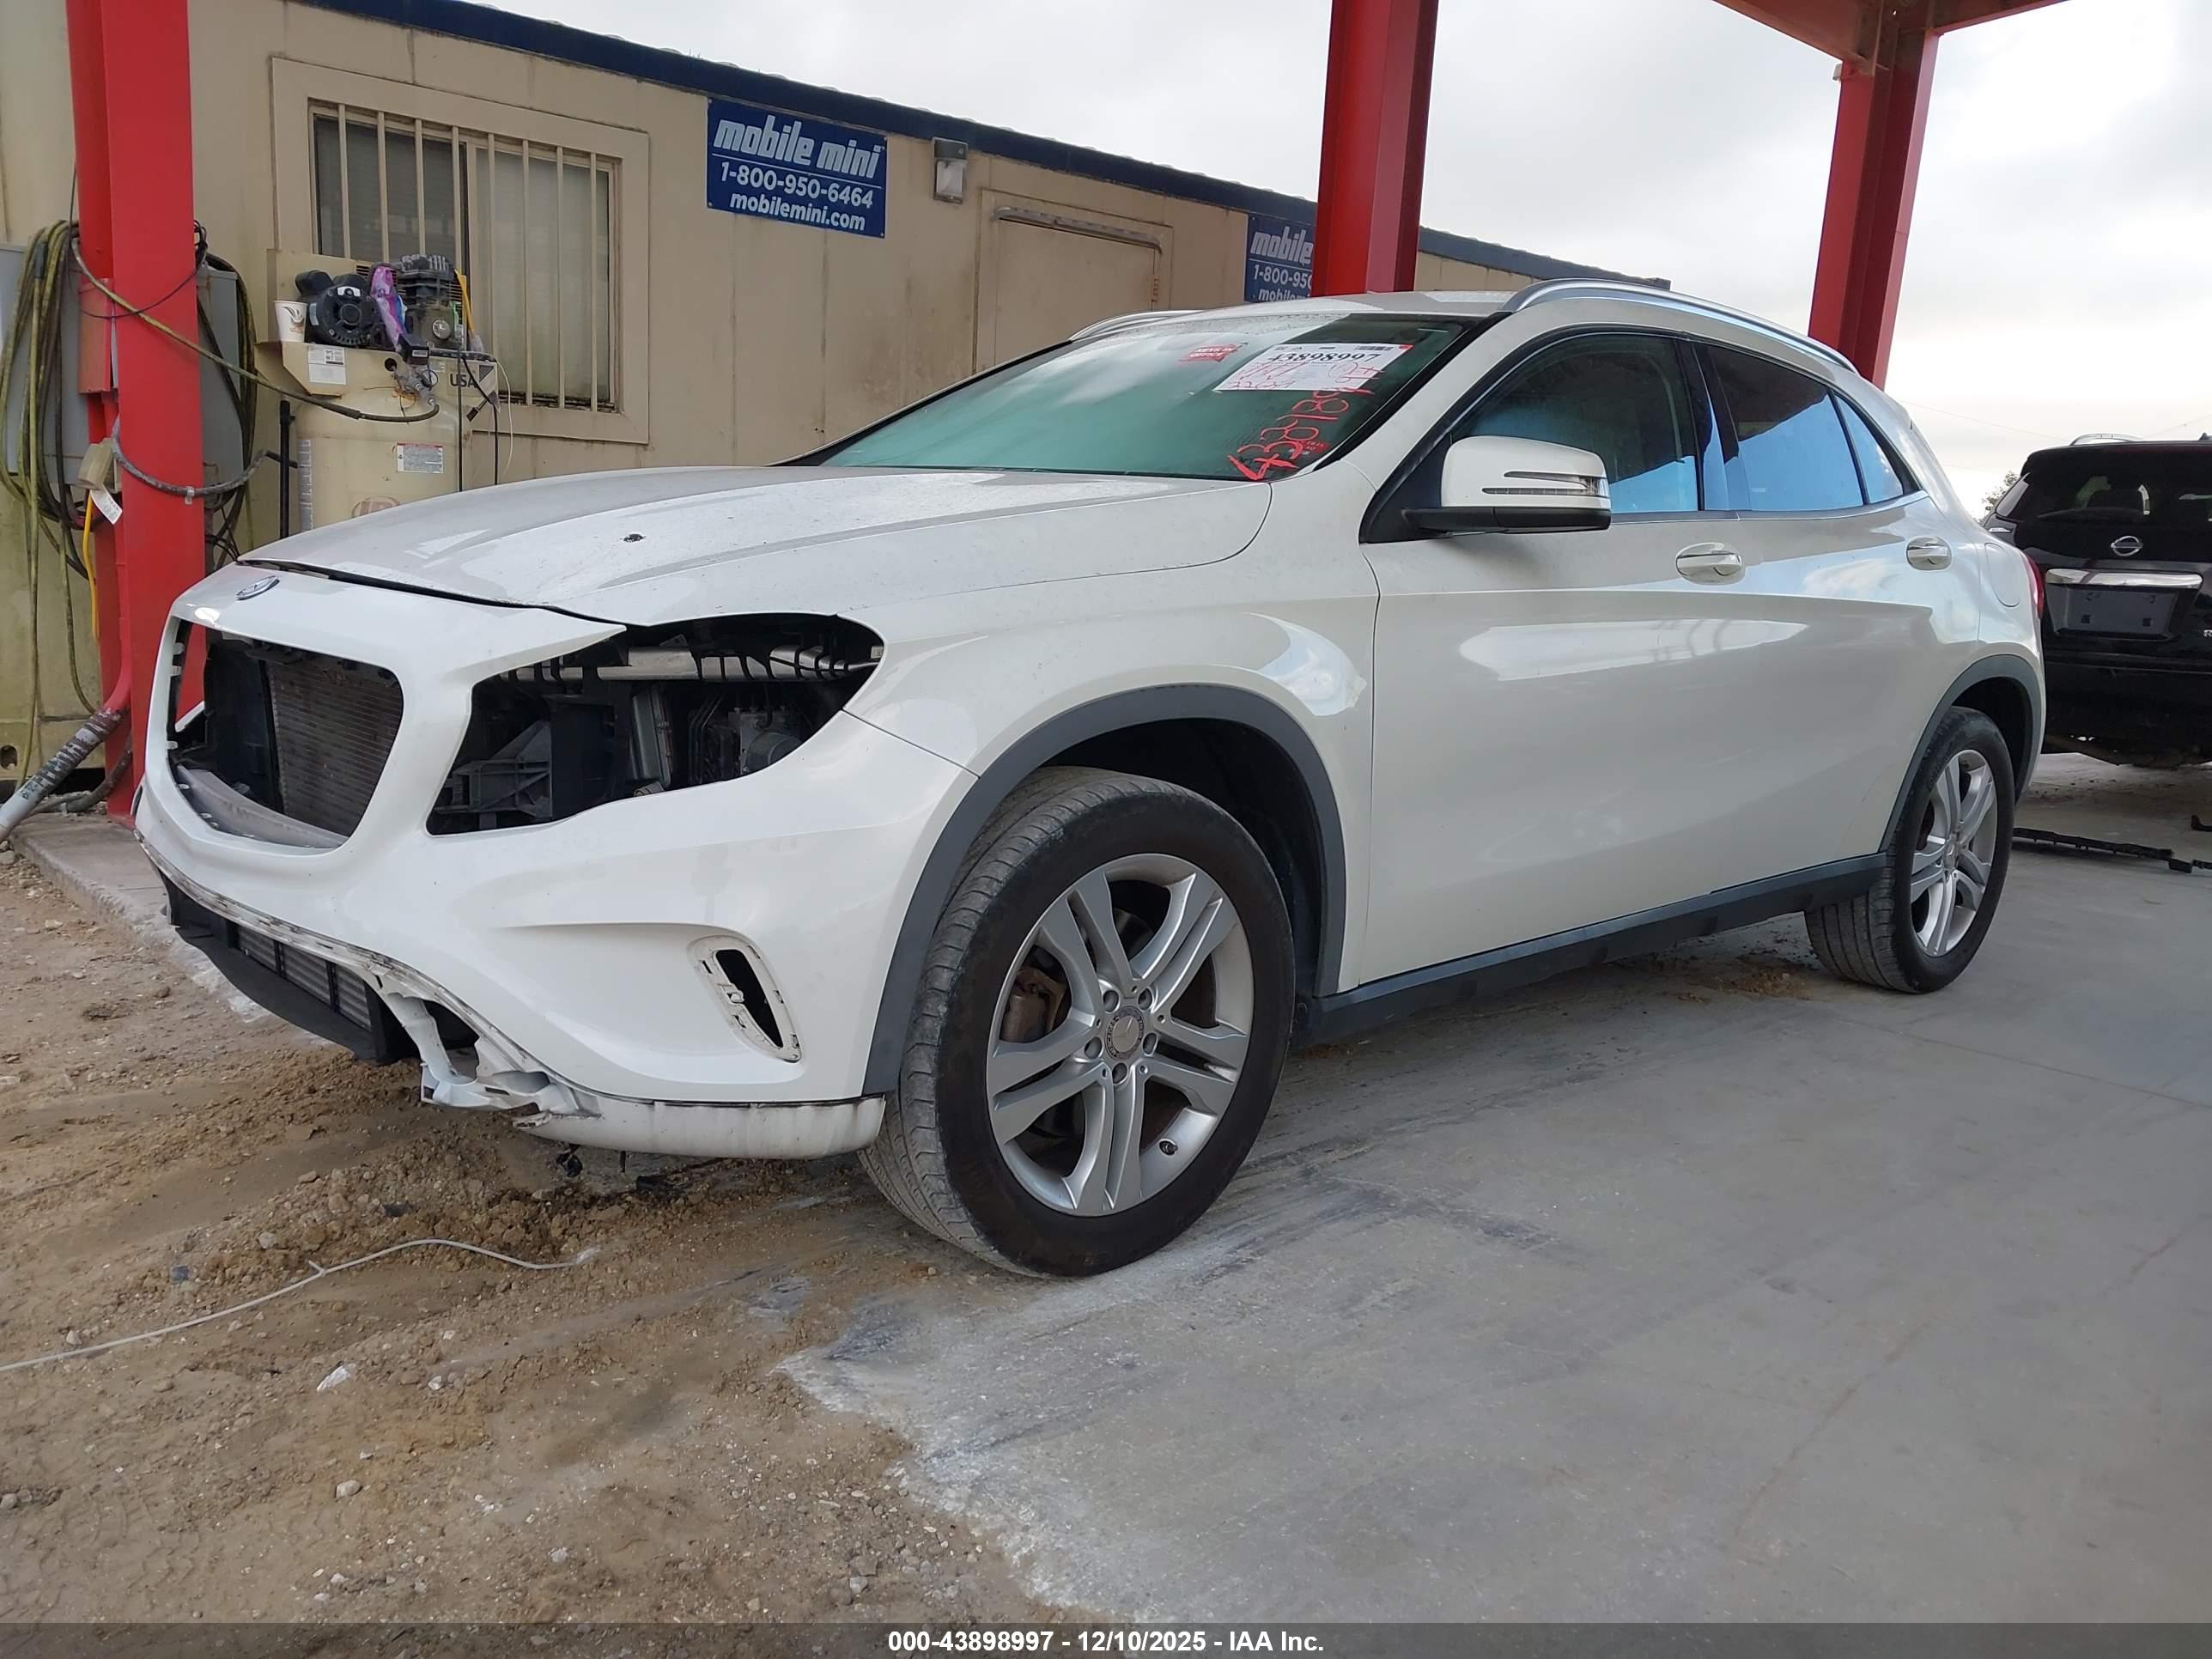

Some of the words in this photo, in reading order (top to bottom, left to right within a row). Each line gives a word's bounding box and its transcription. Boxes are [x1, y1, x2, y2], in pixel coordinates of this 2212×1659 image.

[714, 115, 814, 165] mobile
[817, 139, 881, 179] mini
[721, 161, 873, 209] 1-800-950-6464
[730, 193, 866, 231] mobilemini.com
[1250, 227, 1313, 264] mobile
[450, 373, 478, 388] USA
